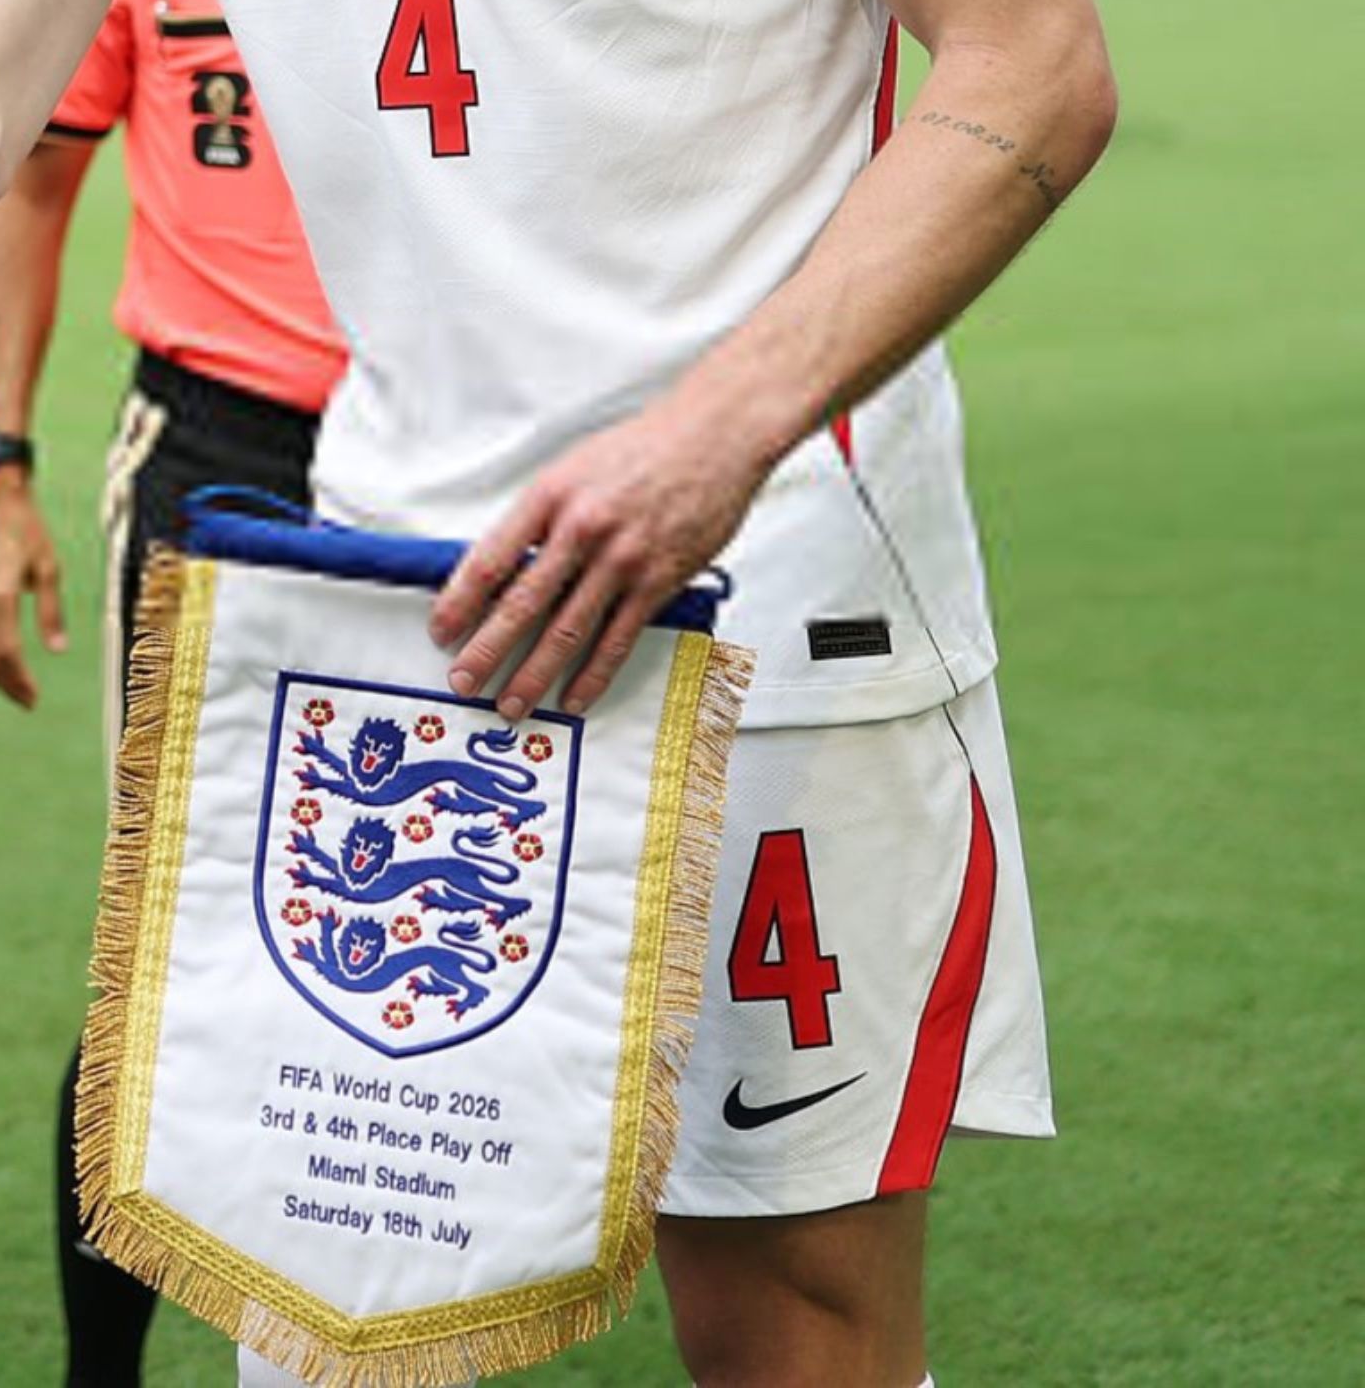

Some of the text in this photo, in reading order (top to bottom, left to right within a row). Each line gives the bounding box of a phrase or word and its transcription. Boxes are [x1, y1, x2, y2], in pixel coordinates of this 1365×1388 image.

[728, 828, 842, 1050] 4
[279, 1065, 501, 1120] FIFA World Cup 2026
[260, 1105, 513, 1165] 3rd & 4th Place Play Off
[307, 1155, 456, 1200] Miami Stadium
[283, 1195, 471, 1250] Saturday 18th July
